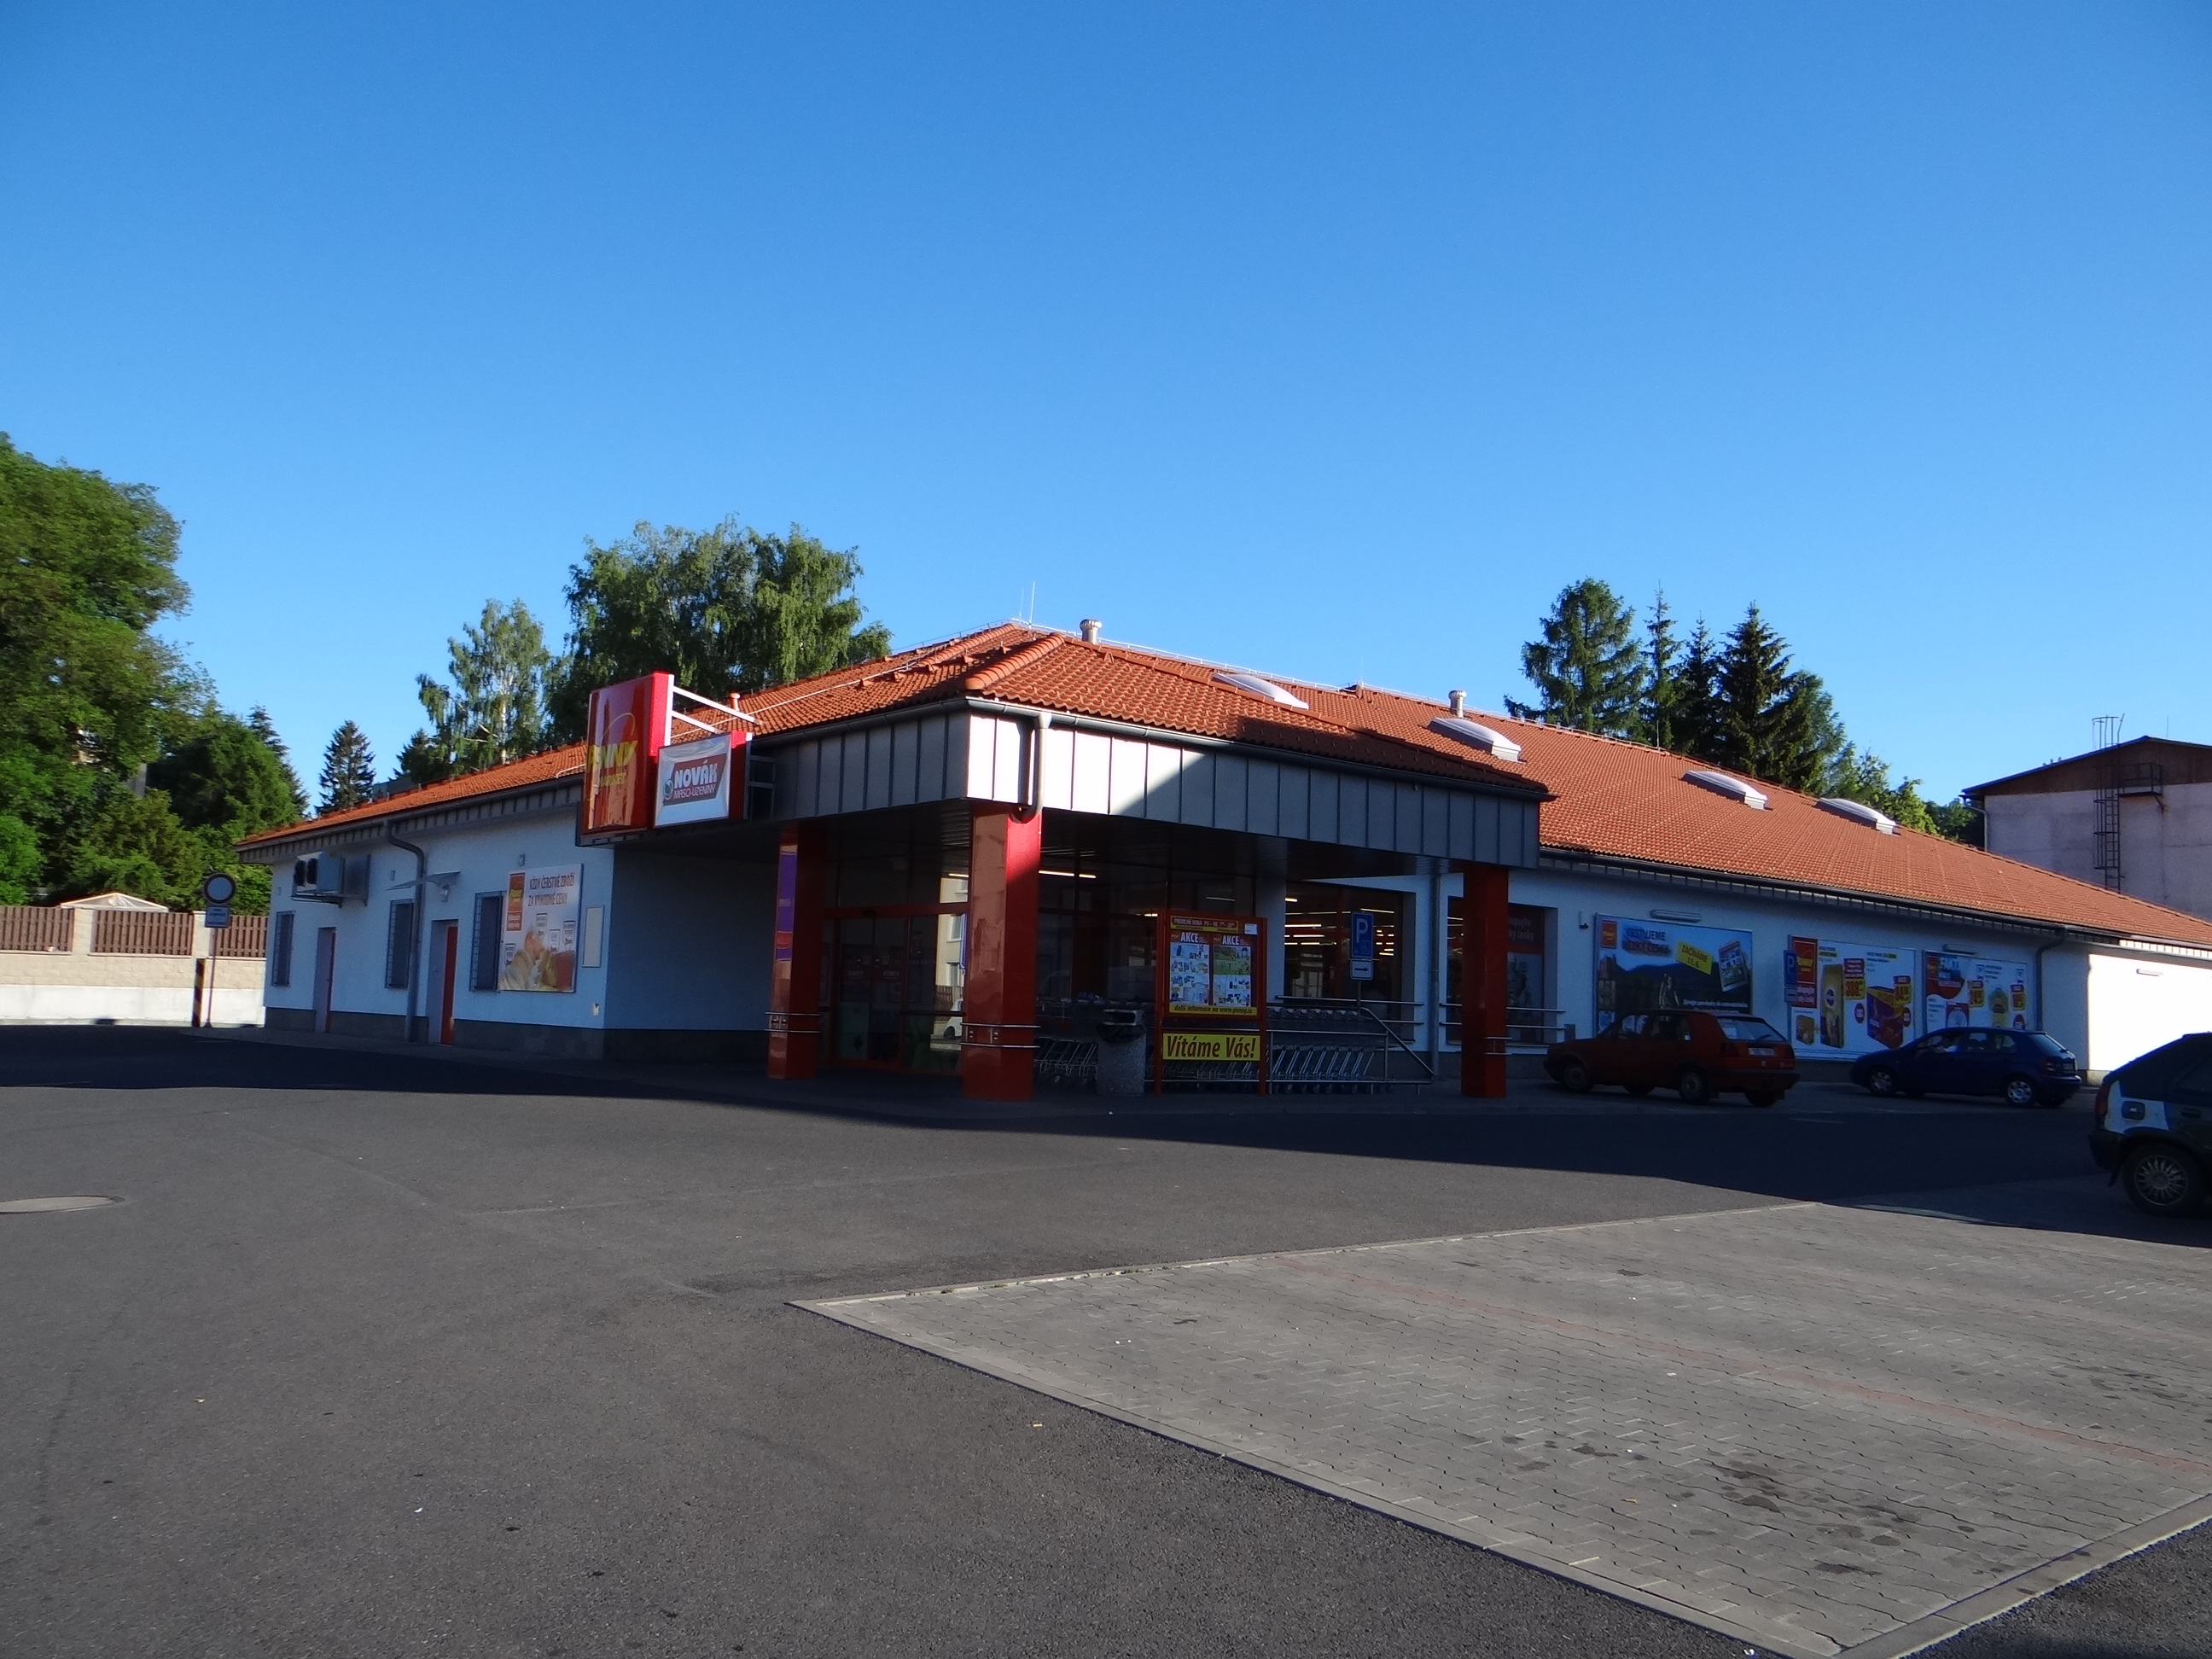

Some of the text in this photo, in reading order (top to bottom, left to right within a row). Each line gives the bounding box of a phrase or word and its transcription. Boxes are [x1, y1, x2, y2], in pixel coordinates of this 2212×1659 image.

[673, 760, 718, 789] NOVÁK
[1180, 931, 1199, 942] AKCE
[1222, 934, 1239, 946] AKCE
[1356, 917, 1369, 944] P
[1167, 1035, 1256, 1058] Vítáme Vás!
